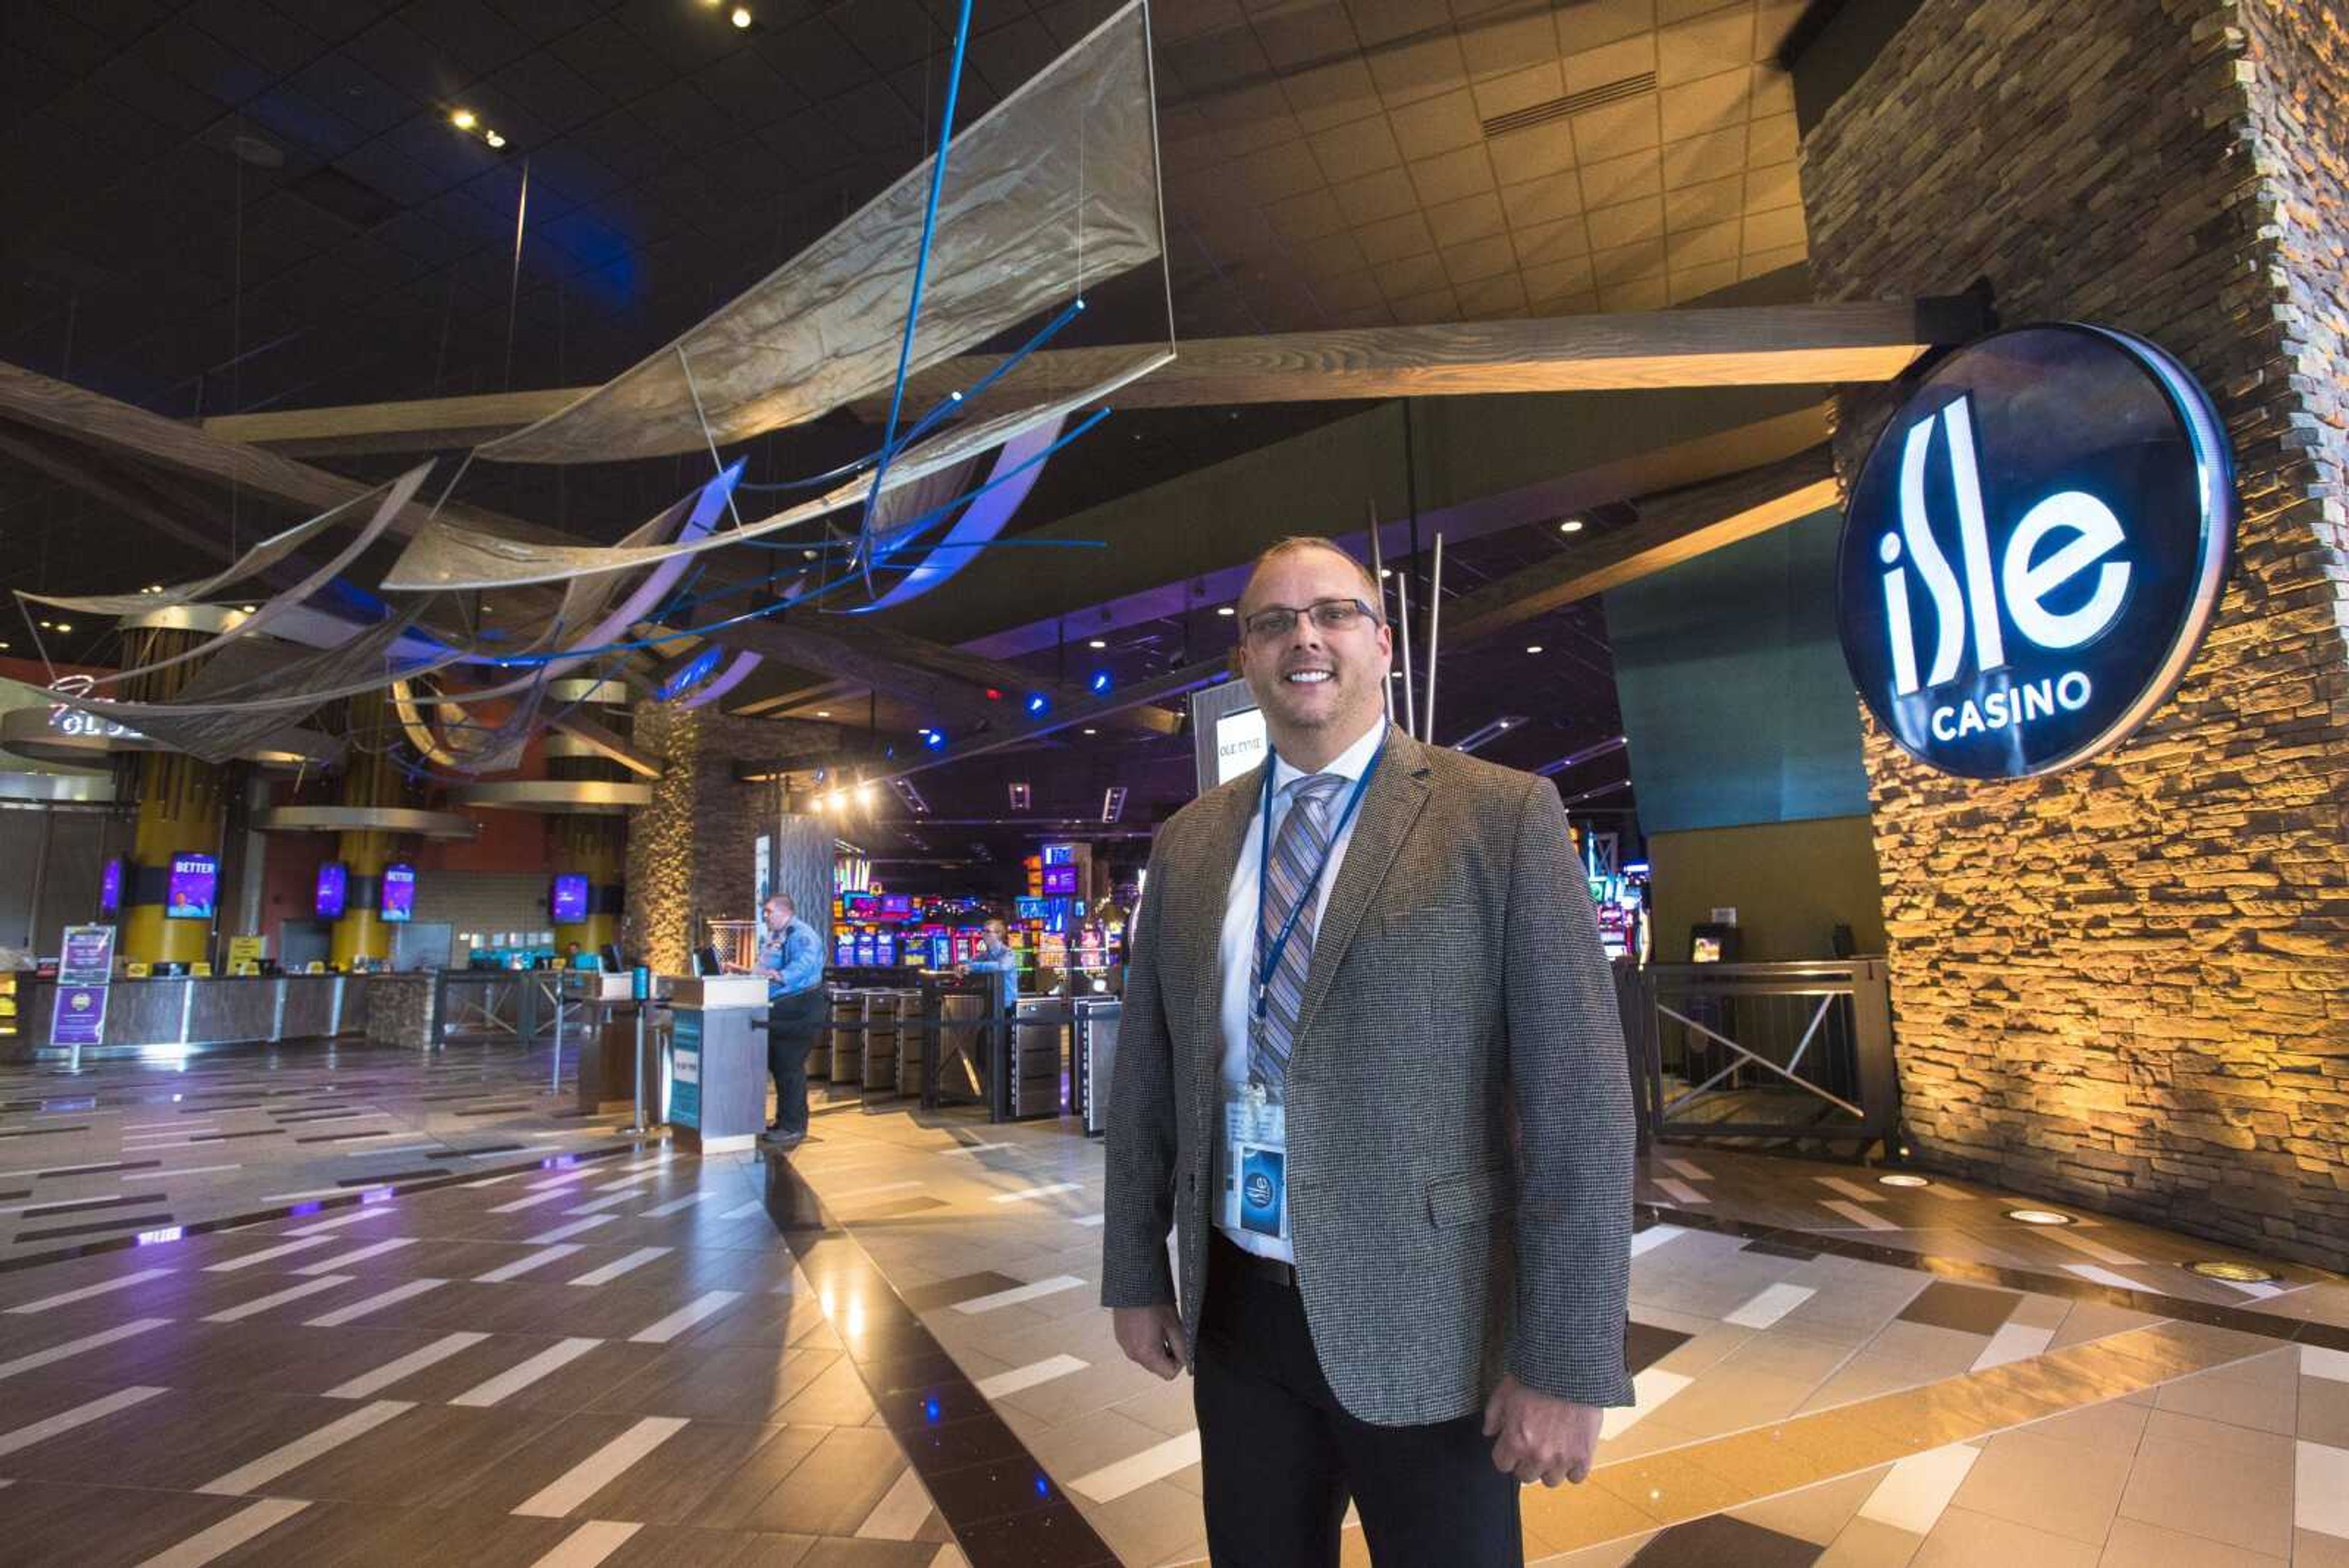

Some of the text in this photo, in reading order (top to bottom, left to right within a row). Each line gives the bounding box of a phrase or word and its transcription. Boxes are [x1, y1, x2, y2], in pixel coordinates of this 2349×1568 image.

[1880, 395, 2131, 696] isle
[1931, 671, 2091, 741] CASINO
[176, 861, 215, 874] BETTER
